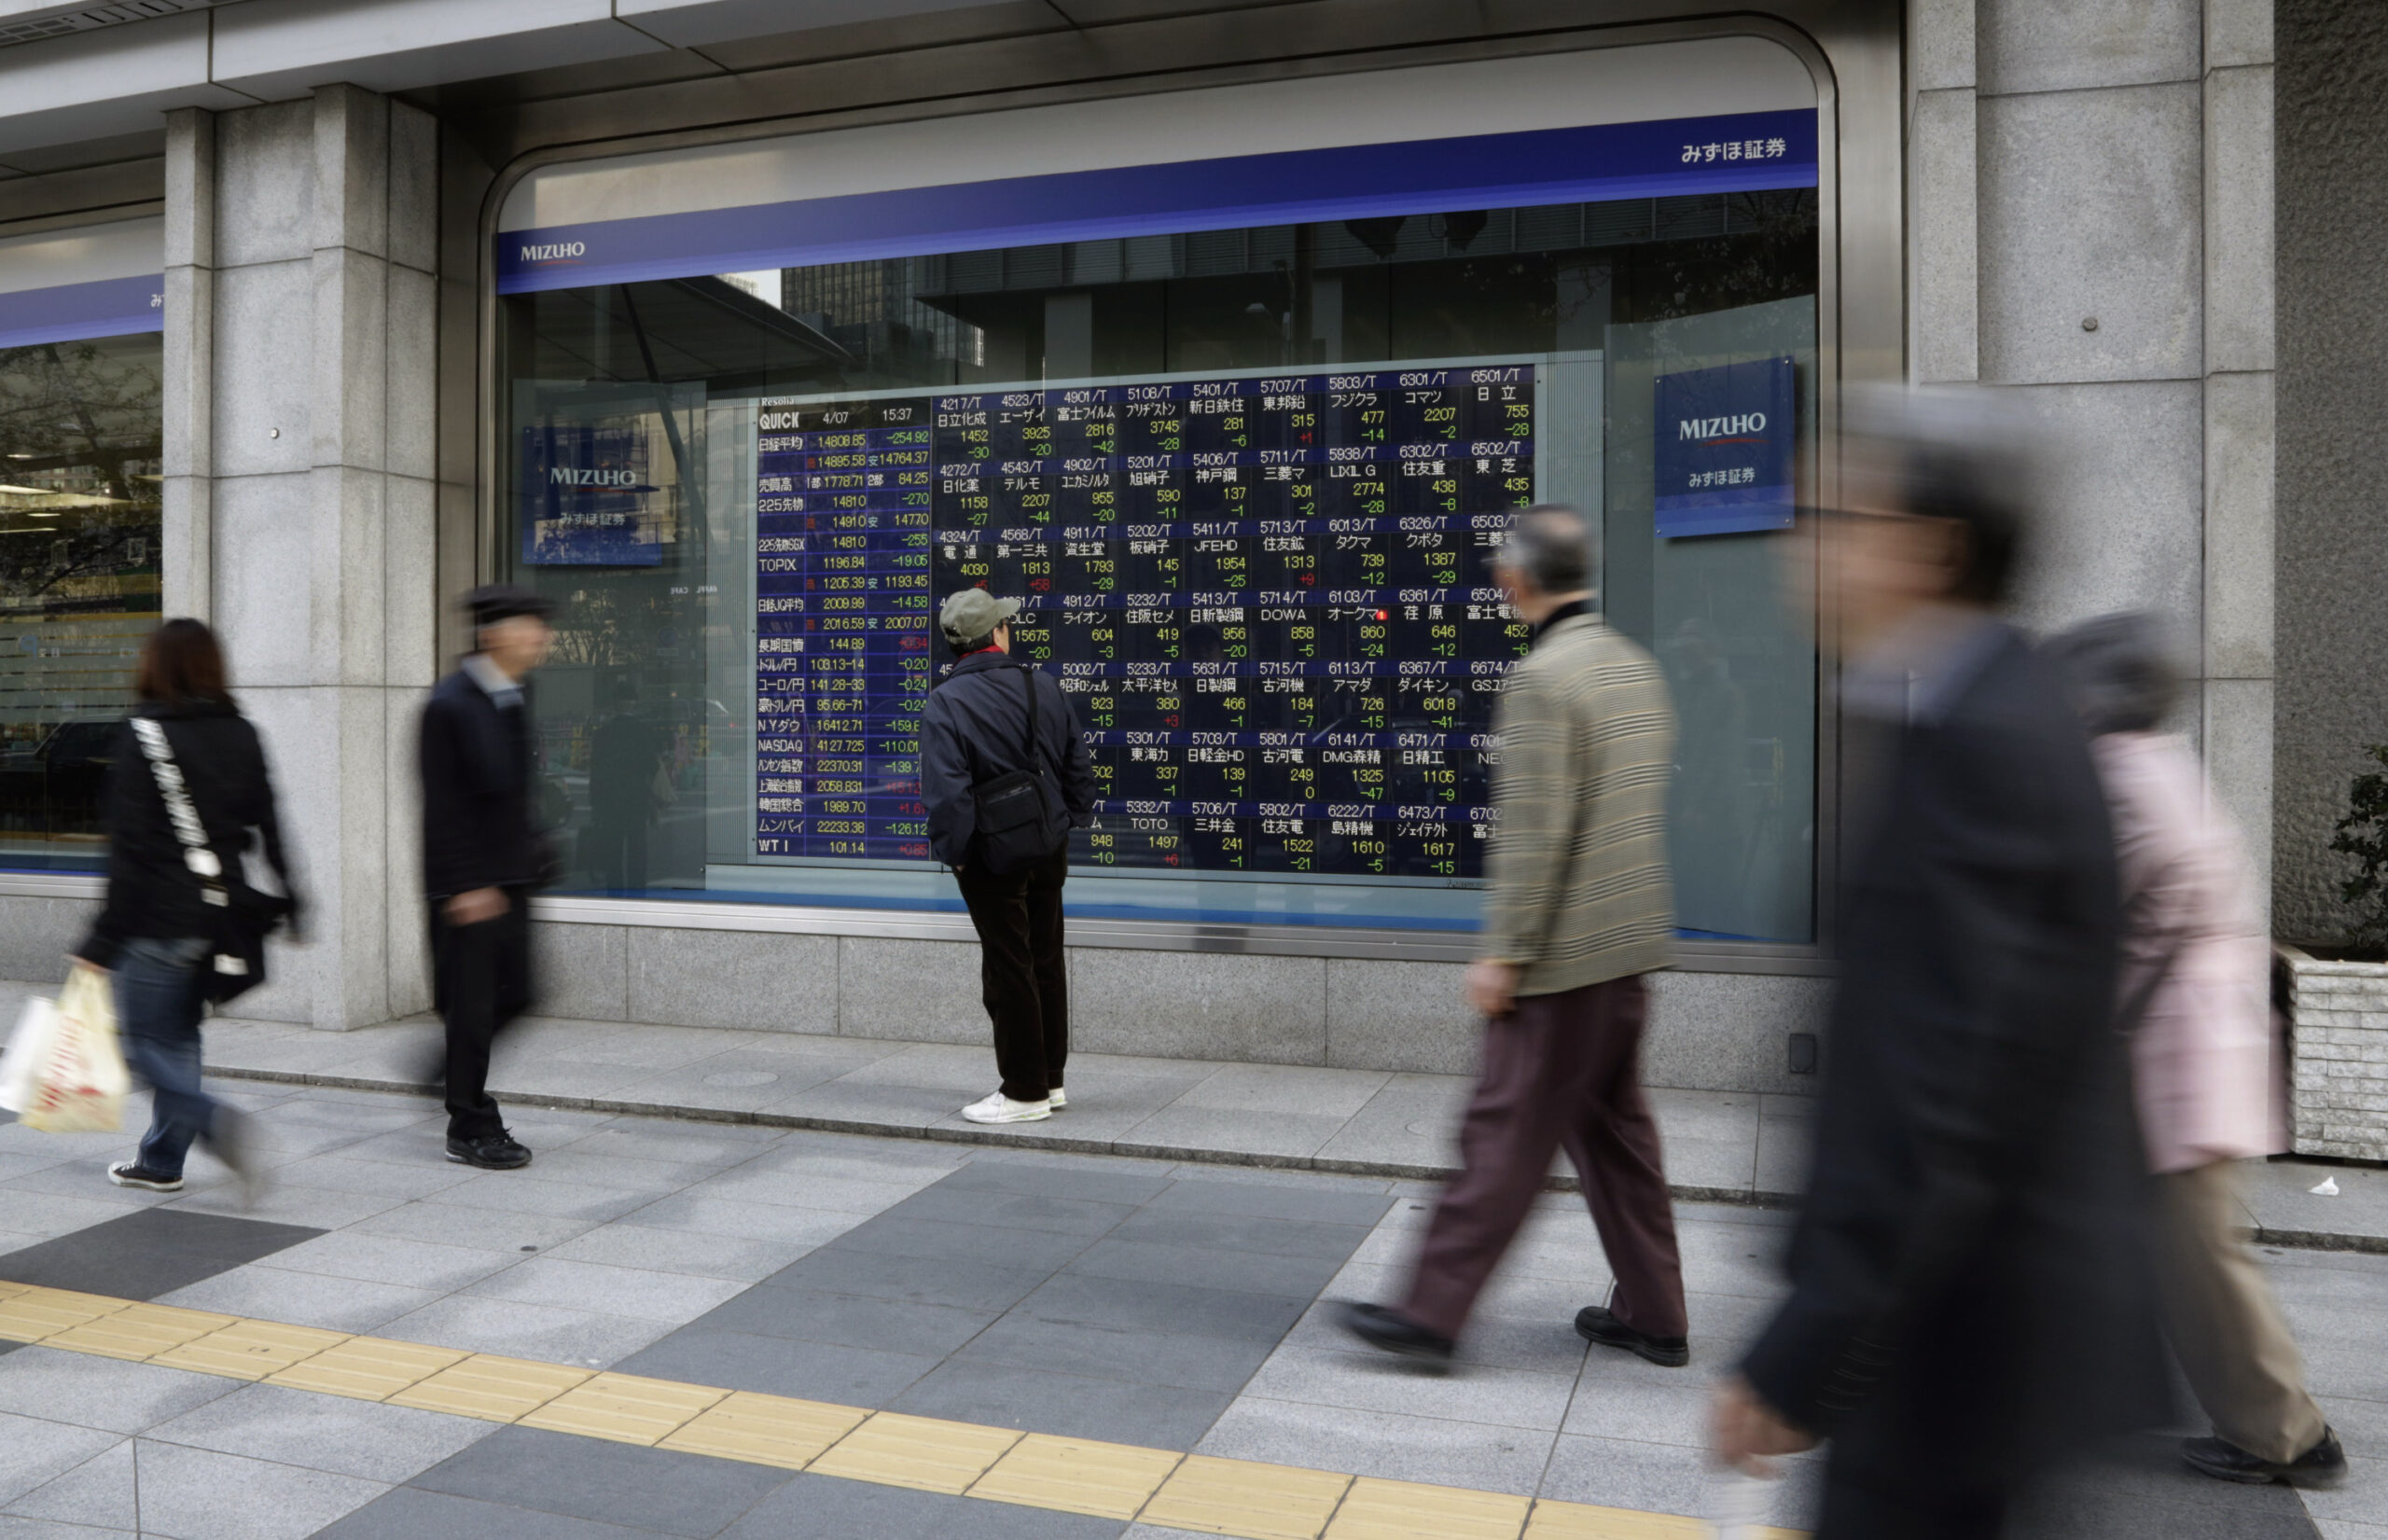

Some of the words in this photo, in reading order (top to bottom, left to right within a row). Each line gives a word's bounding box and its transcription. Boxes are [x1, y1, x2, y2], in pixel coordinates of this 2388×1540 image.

[1681, 137, 1786, 163] みずほ証券
[521, 242, 586, 262] MIZUHO
[1328, 374, 1377, 391] 5803/T
[1470, 368, 1521, 383] 6501/T
[1063, 389, 1107, 404] 4901/T
[1193, 382, 1240, 397] 5401/T
[761, 395, 795, 407] Resolia
[939, 395, 982, 411] 4217/T
[1189, 397, 1244, 414] 新日鉄住
[1330, 391, 1378, 409] フジクラ
[759, 411, 799, 430] QUICK
[822, 411, 849, 424] 4/07
[882, 408, 912, 422] 15:37
[937, 410, 987, 428] 日立化成
[1360, 409, 1385, 424] 477
[1504, 404, 1530, 419] 755
[1085, 423, 1115, 437] 2816
[1223, 417, 1244, 431] 281
[1505, 422, 1531, 437] -28
[1679, 412, 1766, 441] MIZUHO
[758, 436, 803, 452] 日経平均
[818, 433, 867, 449] 14808.85
[885, 429, 929, 445] -254.92
[960, 429, 989, 443] 1452
[1361, 428, 1384, 441] -14
[1260, 449, 1307, 464] 5711/T
[1399, 443, 1449, 459] 6302/T
[817, 453, 867, 468] 14895.58
[879, 451, 929, 465] 14764.37
[1127, 454, 1173, 469] 5201/T
[1000, 460, 1044, 475] 4543/T
[1401, 459, 1446, 477] 住友重
[550, 467, 637, 486] MIZUHO
[758, 477, 793, 493] 売買高
[824, 474, 864, 488] 1778.71
[898, 471, 929, 486] 84.25
[1129, 469, 1171, 486] 旭硝子
[1688, 467, 1756, 488] みずほ証券
[1004, 477, 1041, 492] テルモ
[1291, 484, 1312, 498] 301
[1431, 479, 1457, 493] 438
[758, 497, 804, 512] 225先物
[832, 494, 867, 508] 14810
[900, 492, 929, 506] -270
[1021, 493, 1050, 507] 2207
[1156, 489, 1181, 503] 590
[832, 514, 868, 528] 14910
[895, 512, 931, 526] 14770
[1158, 506, 1177, 519] -11
[1062, 525, 1107, 540] 4911/T
[1192, 521, 1239, 536] 5411/T
[1328, 517, 1377, 533] 6013/T
[832, 535, 867, 548] 14810
[900, 533, 928, 548] -255
[938, 529, 981, 544] 4324/T
[1335, 534, 1372, 550] タクマ
[1065, 541, 1105, 557] 資生堂
[1193, 539, 1238, 552] JFEHD
[758, 558, 797, 572] TOPIX
[823, 555, 866, 569] 1196.84
[891, 553, 928, 567] -19.05
[1085, 560, 1115, 574] 1793
[1215, 556, 1247, 570] 1954
[1360, 553, 1385, 568] 739
[960, 562, 990, 576] 4030
[823, 576, 866, 590] 1205.39
[885, 574, 929, 588] 1193.45
[1091, 576, 1115, 590] -29
[1222, 574, 1246, 588] -25
[1359, 571, 1385, 586] -12
[823, 596, 867, 610] 2009.99
[893, 594, 928, 609] -14.58
[1127, 592, 1172, 607] 5232/T
[1259, 590, 1307, 604] 5714/T
[1398, 588, 1449, 603] 6361/T
[1125, 608, 1174, 624] 住阪セメ
[1260, 608, 1307, 621] DOWA
[823, 617, 866, 631] 2016.59
[884, 616, 929, 630] 2007.07
[1156, 627, 1180, 641] 419
[1290, 626, 1315, 640] 858
[1431, 624, 1456, 639] 646
[829, 637, 866, 650] 144.89
[1430, 641, 1455, 658] -12
[759, 657, 798, 673] ドル/円
[899, 655, 929, 671] -0.20
[1062, 661, 1106, 676] 5002/T
[1192, 661, 1239, 675] 5631/T
[1328, 660, 1377, 675] 6113/T
[811, 678, 866, 691] 141.28-33
[896, 675, 927, 691] -0.24
[1196, 677, 1237, 693] 日製鋼
[1333, 677, 1372, 693] アマダ
[816, 698, 863, 712] 95.66-71
[1090, 696, 1115, 711] 923
[1222, 697, 1246, 711] 466
[1360, 697, 1385, 712] 726
[816, 718, 863, 732] 16412.71
[1090, 714, 1114, 728] -15
[1357, 715, 1384, 729] -15
[1126, 730, 1172, 744] 5301/T
[1259, 731, 1307, 746] 5801/T
[1398, 732, 1447, 747] 6471/T
[757, 739, 803, 753] NASDAQ
[816, 739, 866, 753] 4127.725
[1261, 748, 1304, 764] 古河電
[1402, 749, 1445, 765] 日精工
[816, 759, 863, 773] 22370.31
[1156, 766, 1179, 780] 337
[1290, 768, 1314, 782] 249
[1423, 770, 1456, 784] 1105
[758, 797, 804, 812] 韓国総合
[823, 799, 867, 814] 1989.70
[1191, 801, 1238, 815] 5706/T
[1327, 804, 1376, 818] 6222/T
[758, 818, 805, 834] ムンバイ
[816, 820, 866, 834] 22233.38
[884, 822, 927, 836] -126.12
[1194, 817, 1236, 833] 三井金
[829, 840, 866, 854] 101.14
[1090, 833, 1114, 848] 948
[1222, 837, 1243, 851] 241
[1352, 839, 1385, 854] 1610
[1089, 850, 1115, 865] -10
